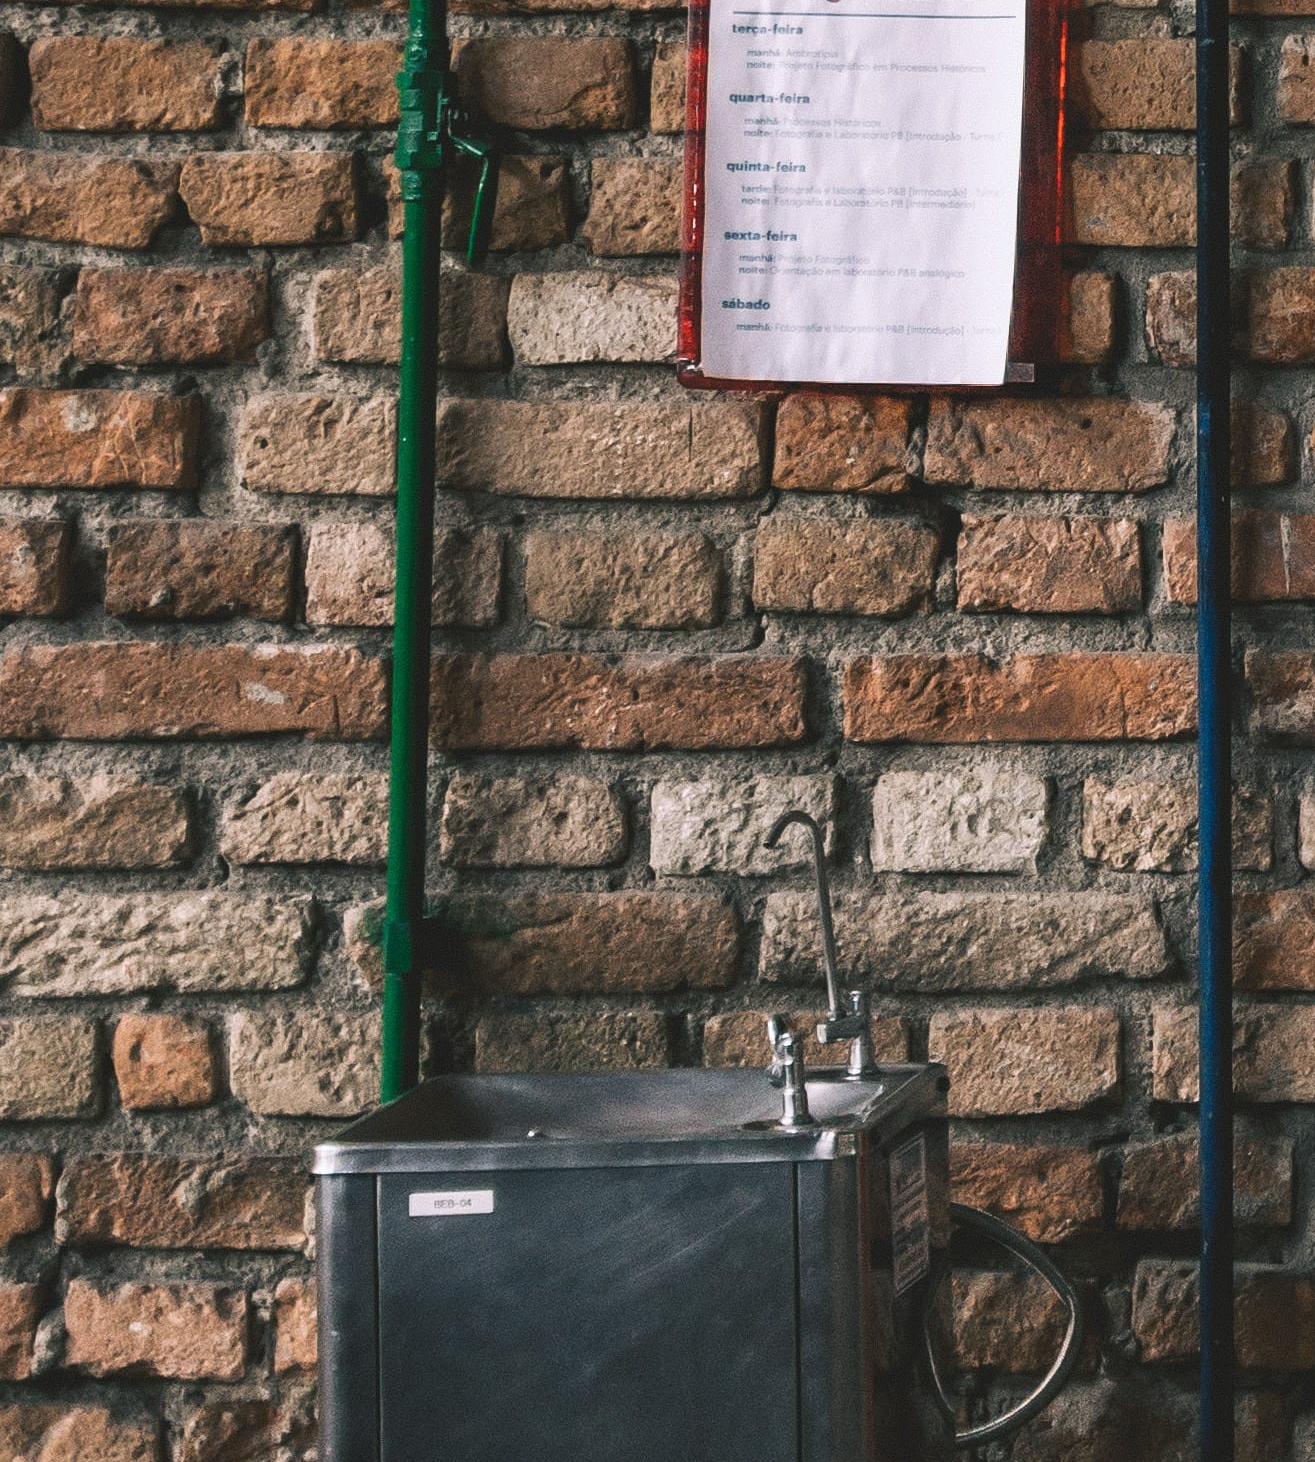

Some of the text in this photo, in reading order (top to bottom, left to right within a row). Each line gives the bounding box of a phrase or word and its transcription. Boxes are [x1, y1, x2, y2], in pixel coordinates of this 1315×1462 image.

[732, 23, 803, 36] terça-feira
[890, 63, 938, 73] Processos
[941, 64, 986, 74] Históricos
[728, 92, 810, 104] quarta-feira
[833, 118, 880, 127] Históricos
[774, 130, 822, 140] Fotografia
[726, 161, 806, 173] quinta-feira
[773, 185, 822, 195] Fotografia
[887, 186, 904, 196] P&B
[773, 197, 823, 208] Fotografia
[724, 230, 797, 241] sexta-feira
[770, 266, 823, 276] Orientação
[897, 268, 915, 277] P&B
[918, 268, 965, 280] analógico
[722, 298, 770, 310] sábado
[774, 323, 822, 333] Fotografia
[434, 1199, 472, 1209] BEB-04
